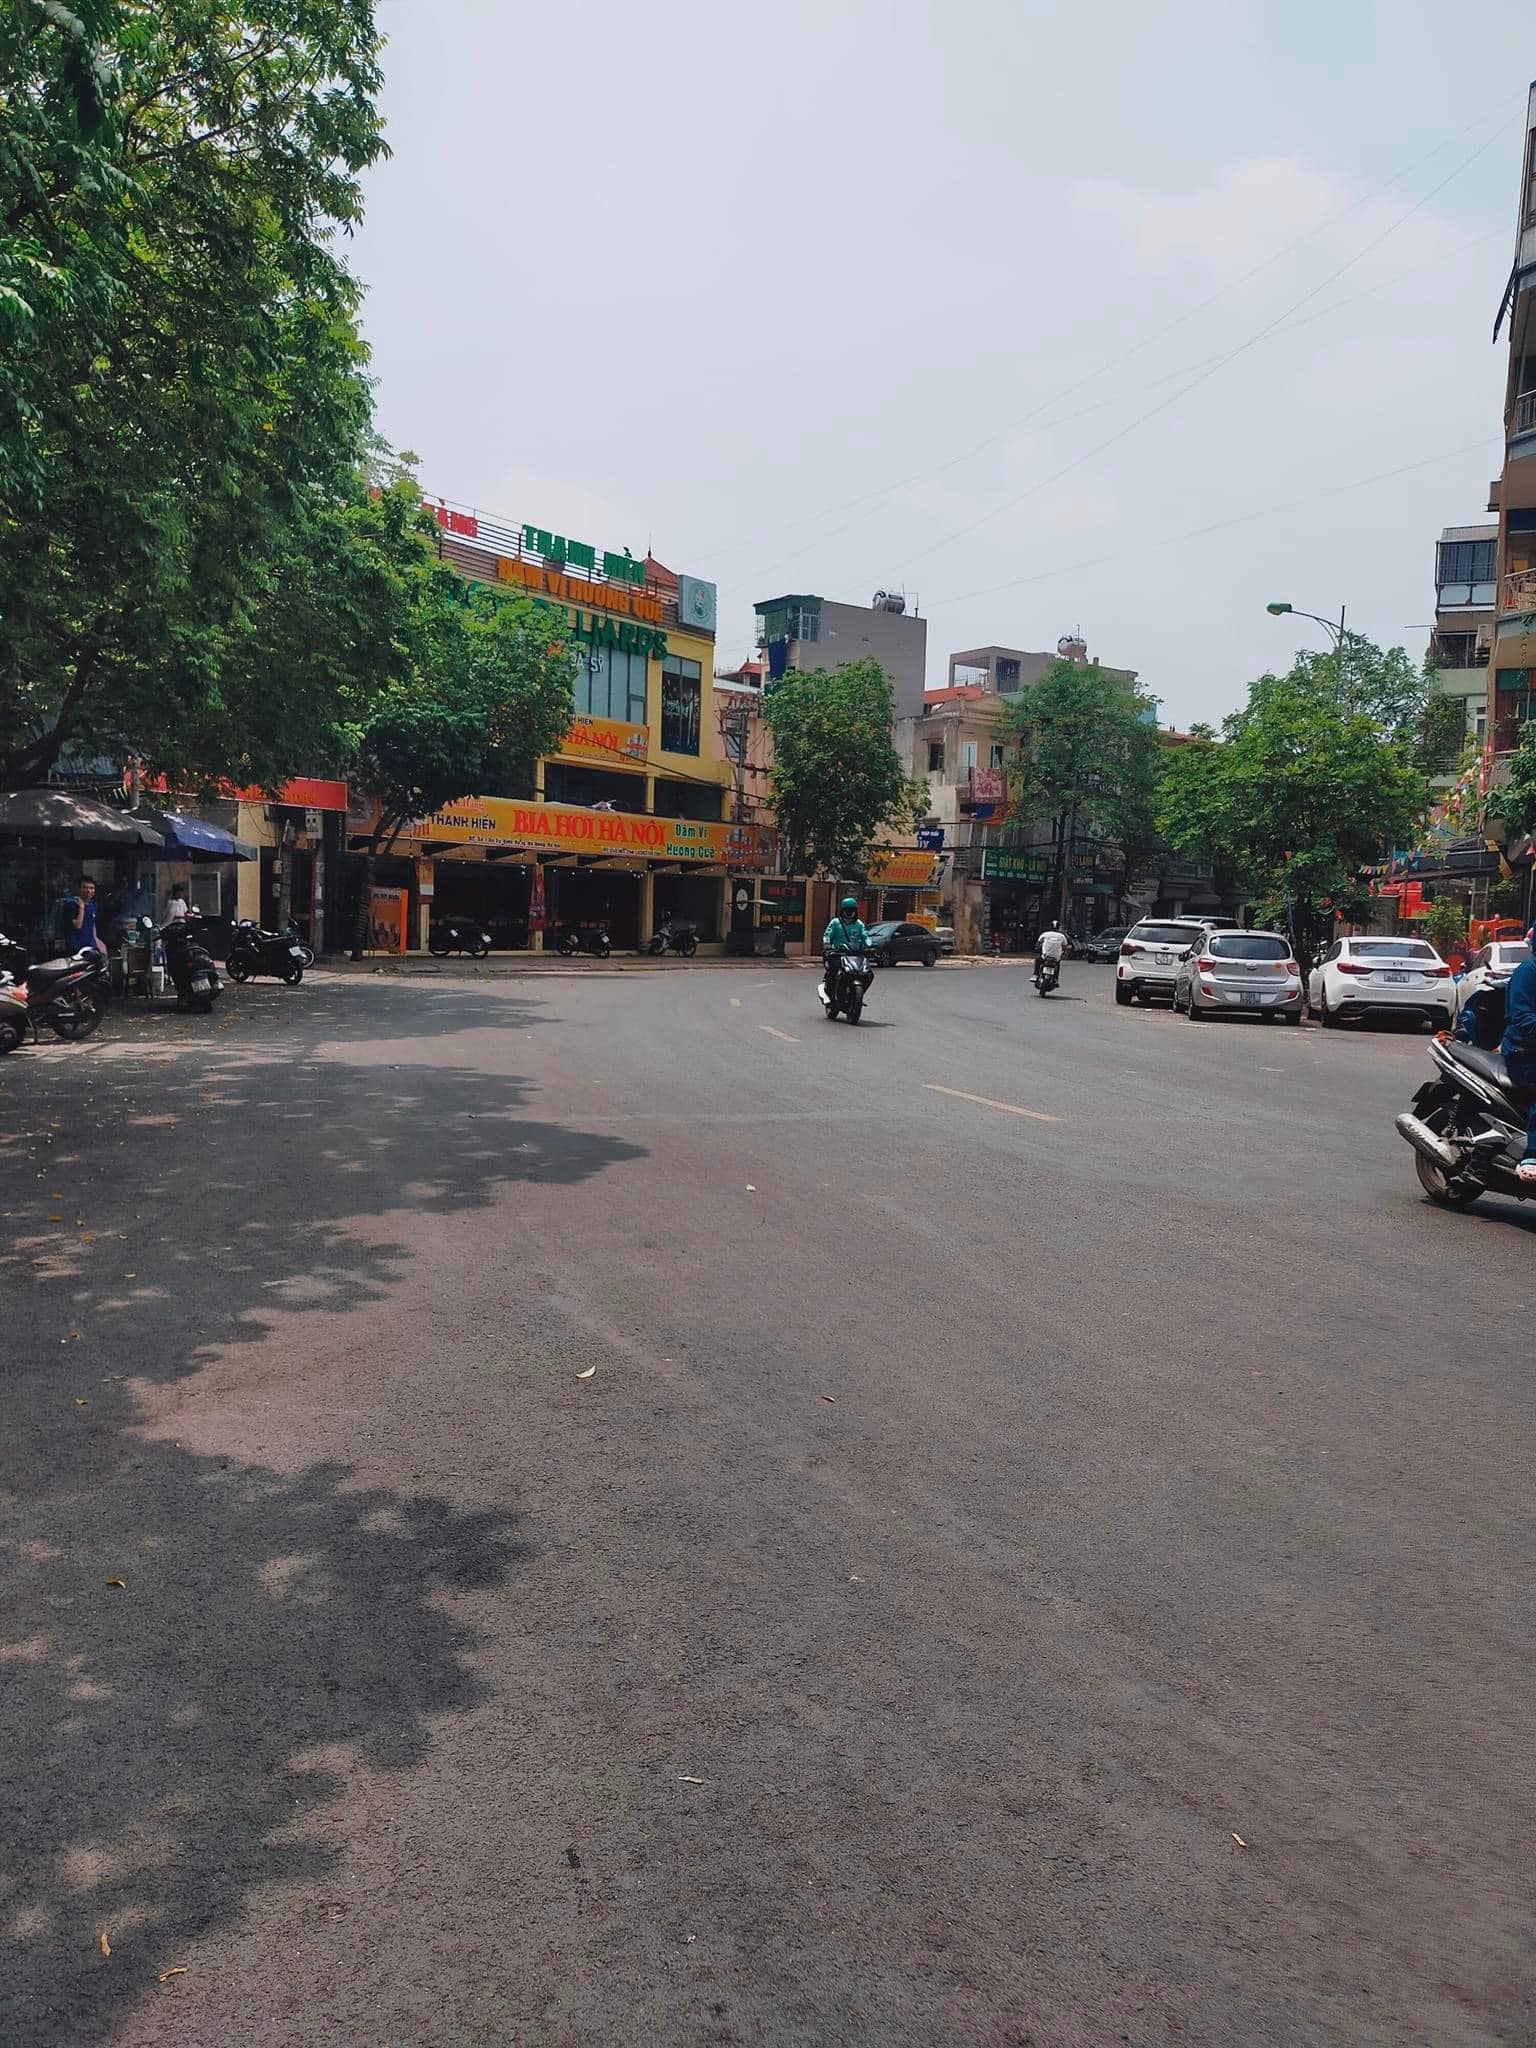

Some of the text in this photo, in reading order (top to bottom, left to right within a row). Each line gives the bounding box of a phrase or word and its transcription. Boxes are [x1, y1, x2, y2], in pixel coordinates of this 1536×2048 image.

[522, 524, 595, 570] THANH
[431, 813, 469, 828] THANH
[513, 809, 666, 849] BIA HƠI HÀ NỘI
